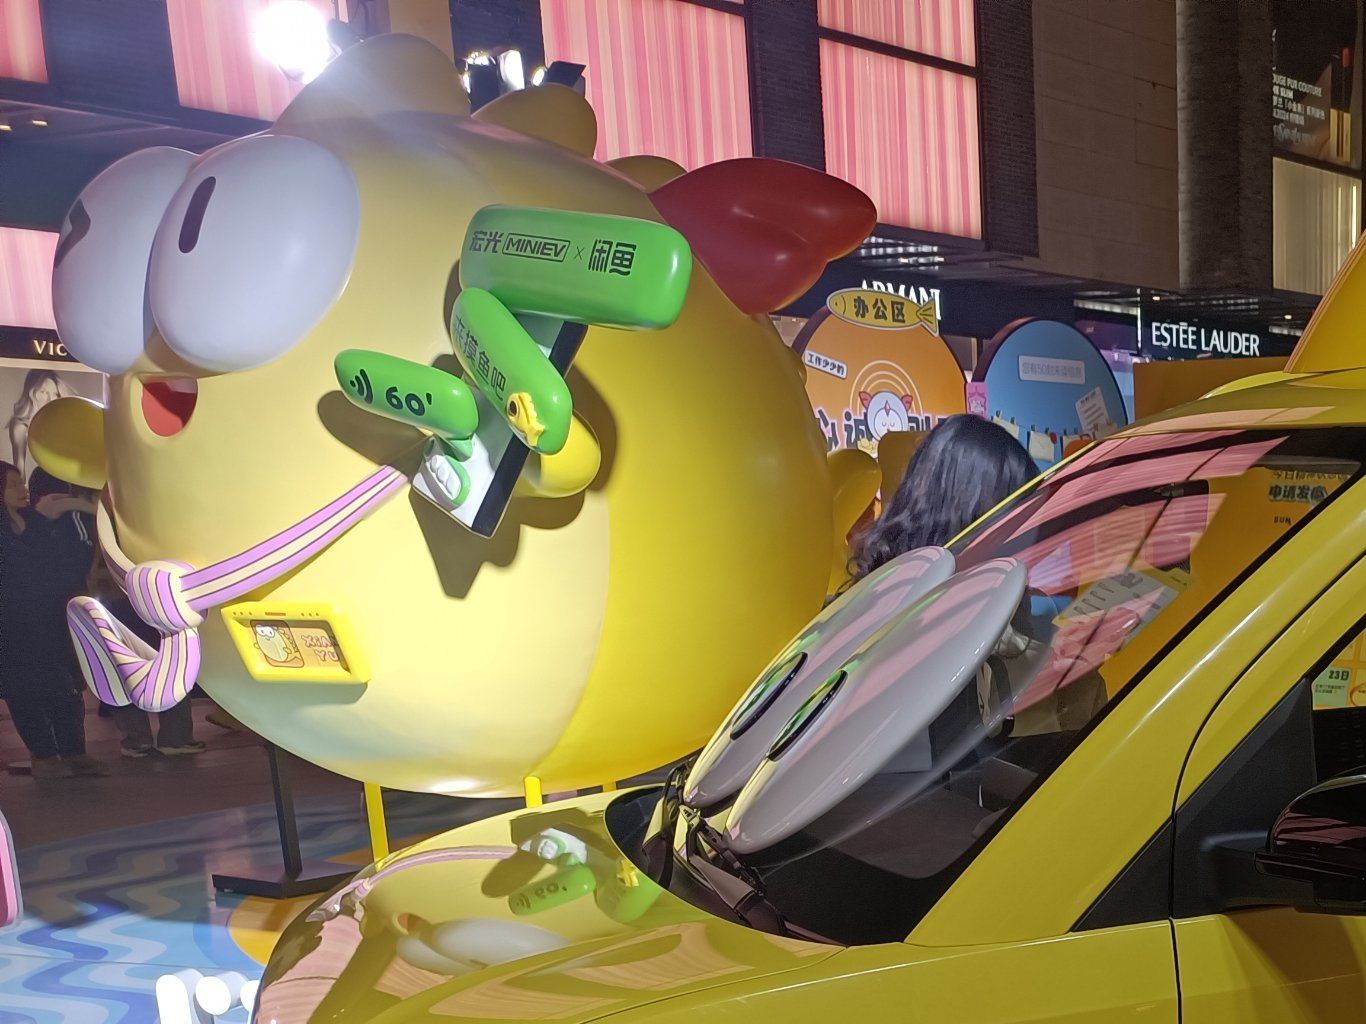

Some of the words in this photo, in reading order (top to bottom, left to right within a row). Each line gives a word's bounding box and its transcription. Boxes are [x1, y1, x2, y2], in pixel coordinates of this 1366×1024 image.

[469, 230, 503, 254] 宏光
[502, 234, 569, 261] MINIEV
[588, 239, 637, 276] 闲鱼
[854, 295, 906, 323] 办公区
[1201, 327, 1260, 357] LAUDER
